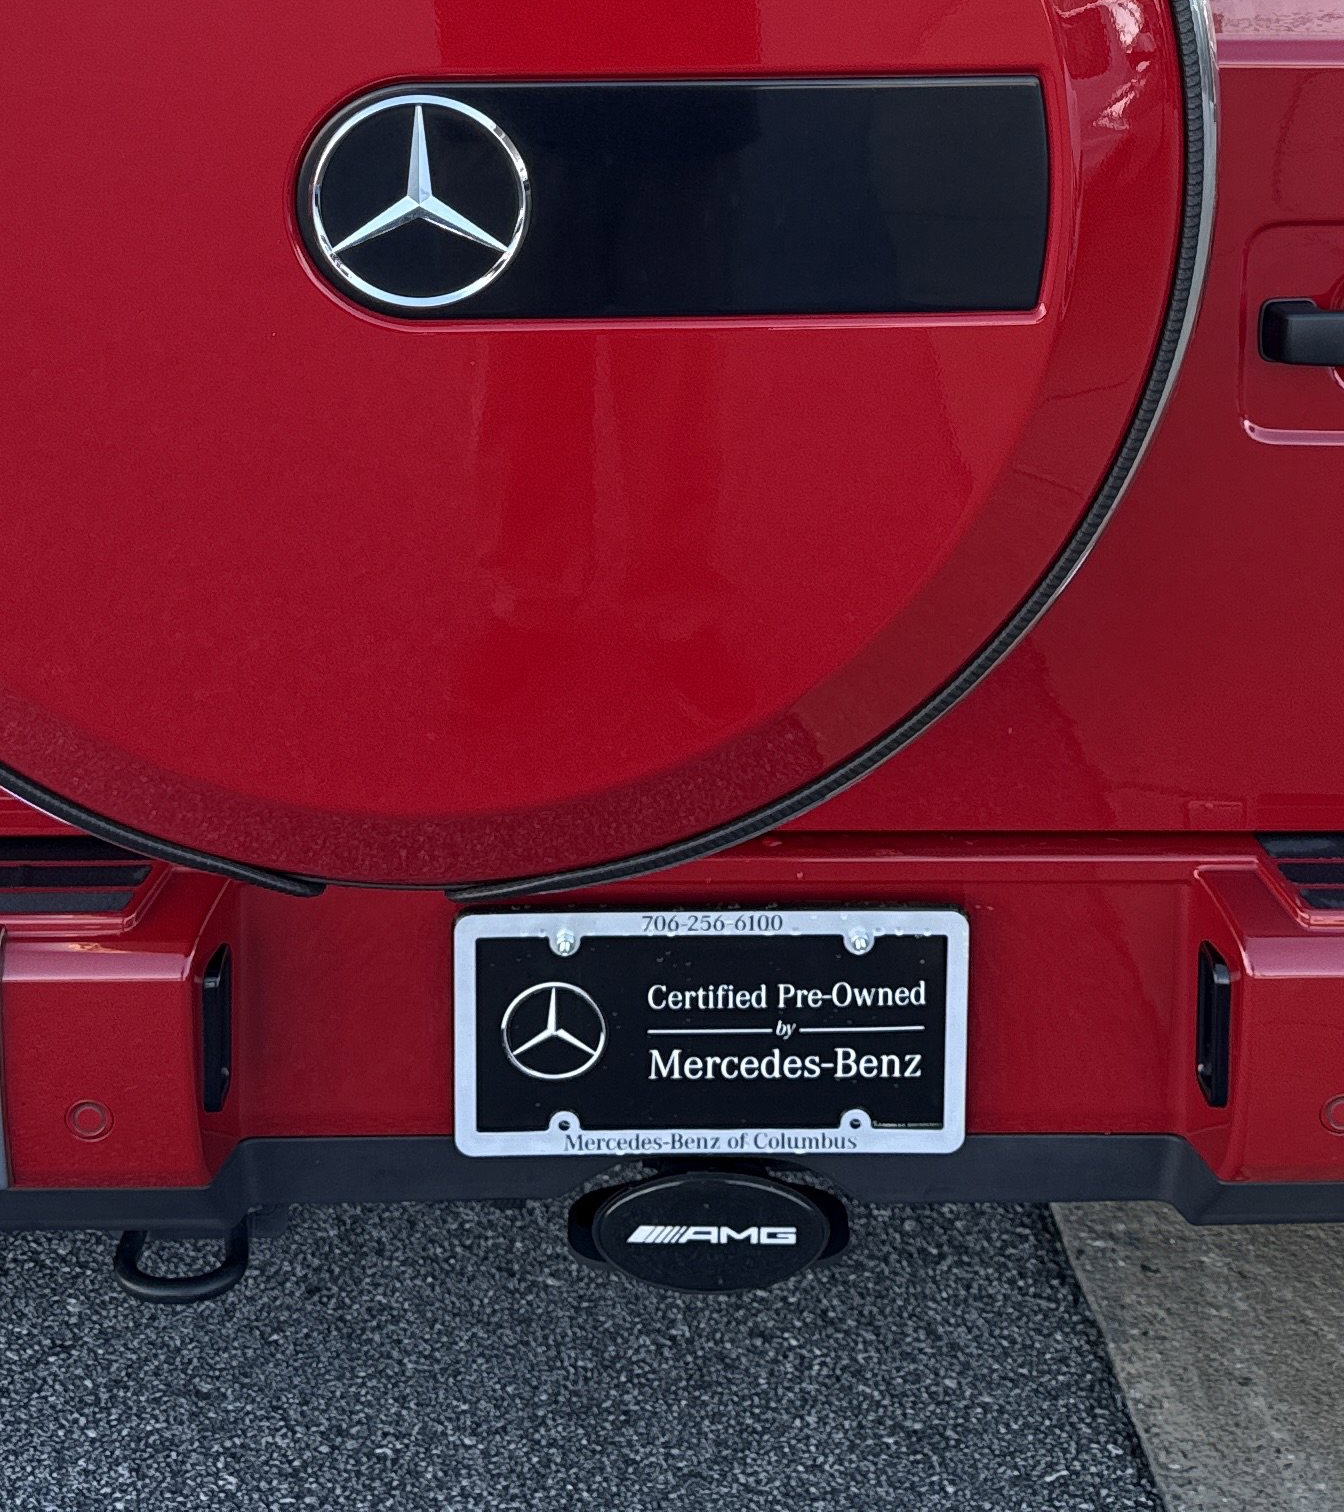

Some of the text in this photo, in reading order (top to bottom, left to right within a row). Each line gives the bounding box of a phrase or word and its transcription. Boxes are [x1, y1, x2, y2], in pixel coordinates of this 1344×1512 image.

[642, 915, 783, 931] 706-256-6100
[648, 981, 926, 1010] Certified Pre-Owned
[776, 1020, 796, 1038] by
[648, 1049, 922, 1080] Mercedes-Benz
[564, 1134, 857, 1151] Mercedes-Benz of Columbus
[682, 1227, 796, 1244] AMG
